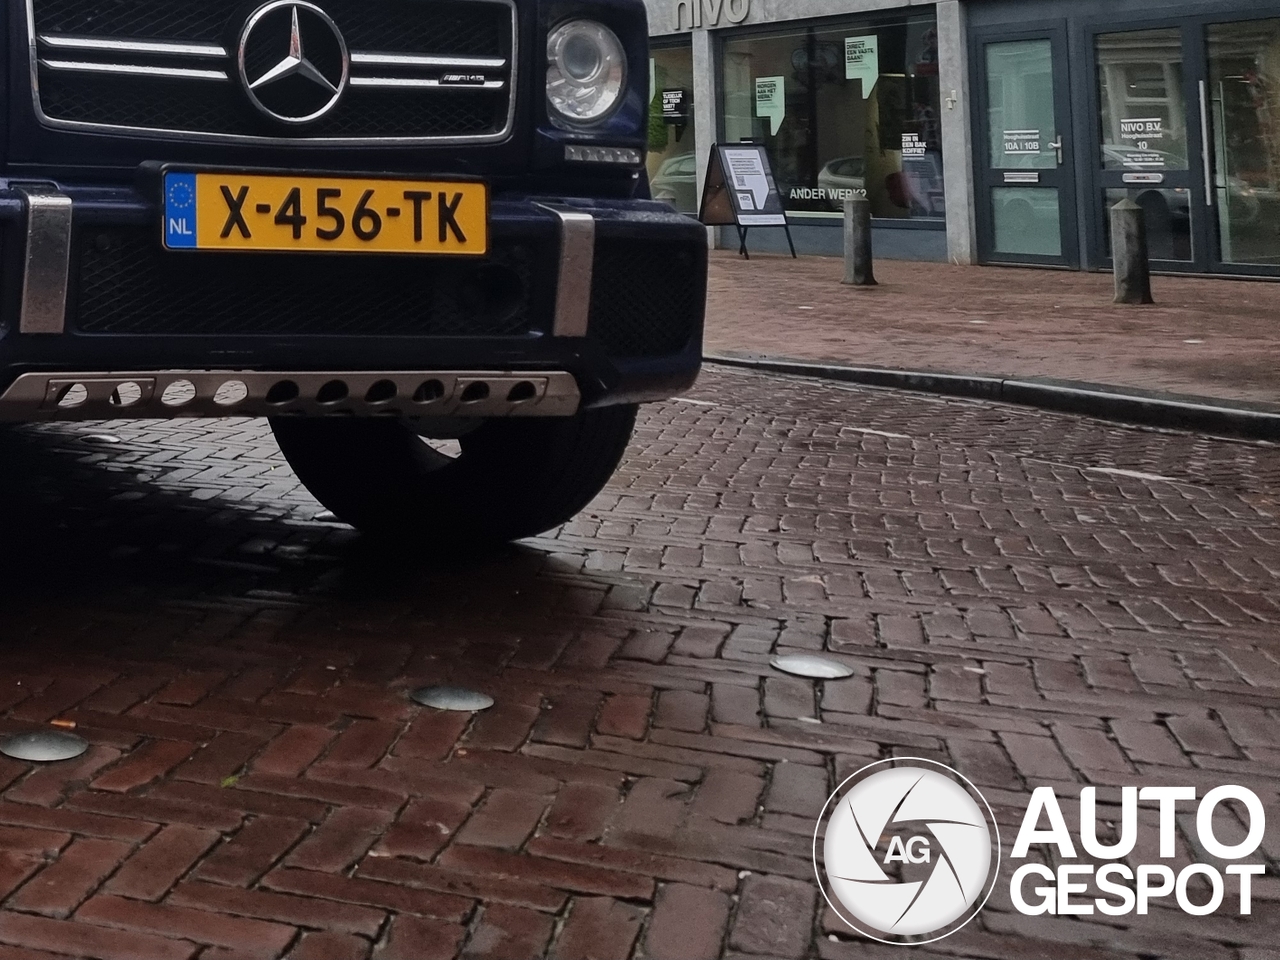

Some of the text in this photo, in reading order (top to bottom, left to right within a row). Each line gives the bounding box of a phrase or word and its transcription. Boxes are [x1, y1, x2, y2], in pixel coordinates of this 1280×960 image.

[1121, 123, 1144, 132] NIVO
[1004, 142, 1019, 150] 10A
[1024, 141, 1039, 150] 10B
[1137, 141, 1148, 150] 10
[789, 188, 826, 199] ANDER
[218, 185, 468, 244] X-456-TK
[169, 218, 192, 236] NL
